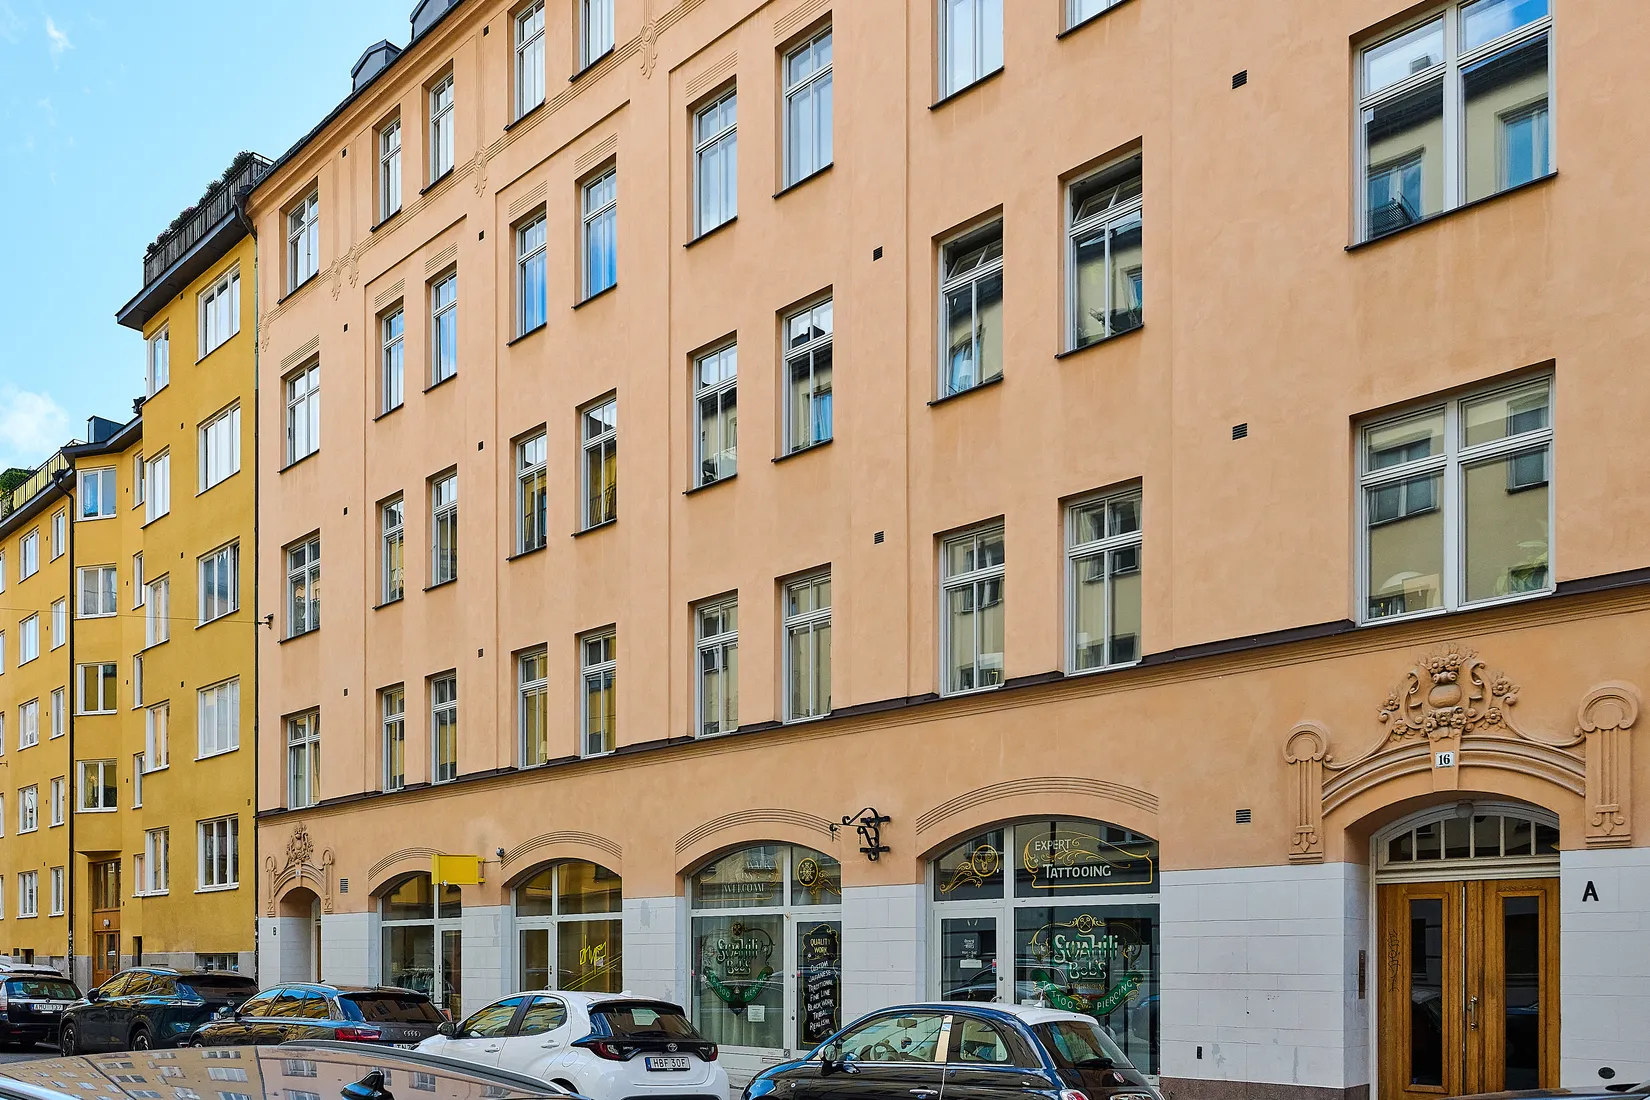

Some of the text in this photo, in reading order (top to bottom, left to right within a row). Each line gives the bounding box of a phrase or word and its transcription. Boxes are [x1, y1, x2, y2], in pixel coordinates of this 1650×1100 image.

[1439, 753, 1451, 766] 16
[1035, 839, 1072, 853] EXPERT
[723, 883, 767, 893] WELCOME
[1581, 880, 1600, 902] A
[810, 938, 831, 948] QUALITY
[813, 946, 829, 955] WORK
[1096, 979, 1134, 1010] PIERCING
[653, 1058, 668, 1067] HBF
